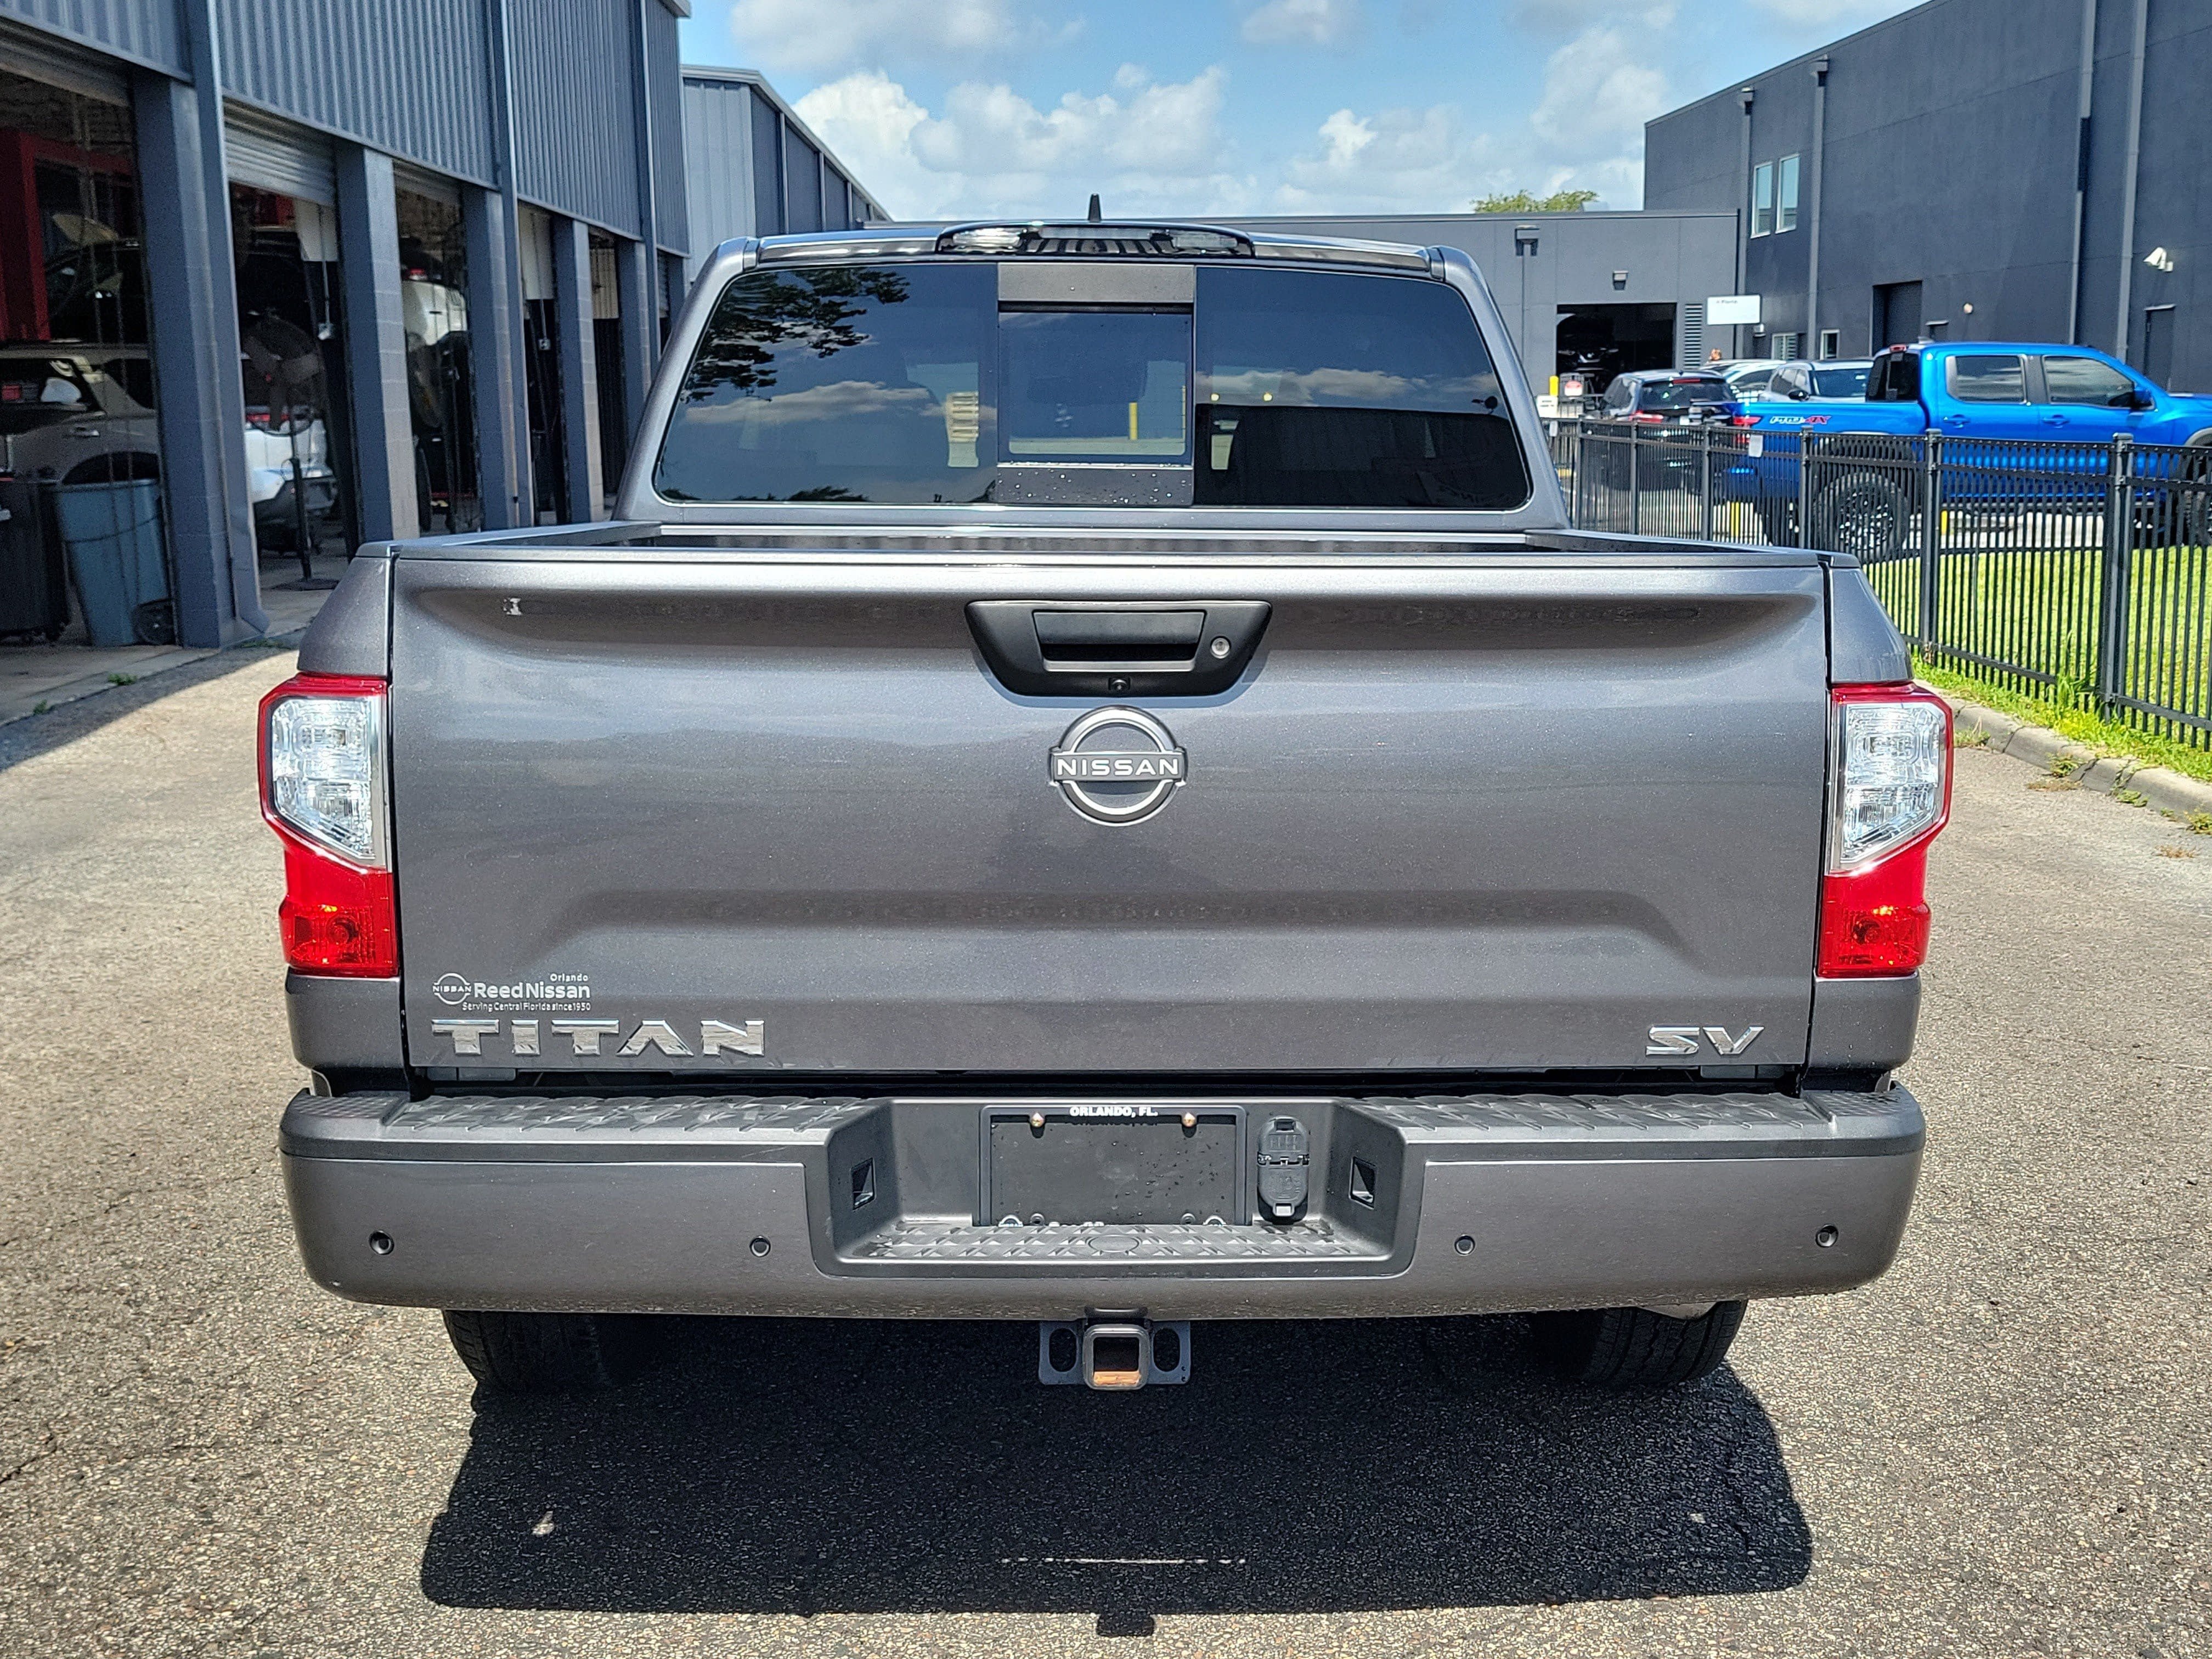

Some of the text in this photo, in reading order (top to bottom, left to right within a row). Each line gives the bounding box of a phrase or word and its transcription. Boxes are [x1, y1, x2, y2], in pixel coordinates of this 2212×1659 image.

[1057, 758, 1179, 776] NISSAN
[550, 973, 589, 981] Orlando
[474, 981, 590, 998] Reed Nissan
[462, 1002, 493, 1012] Serving
[494, 1002, 522, 1011] Central
[523, 1002, 551, 1011] Florida
[552, 1002, 572, 1011] since
[431, 1018, 765, 1057] TITAN
[1646, 1026, 1765, 1056] SV
[1070, 1106, 1158, 1118] ORLANDO, FL.
